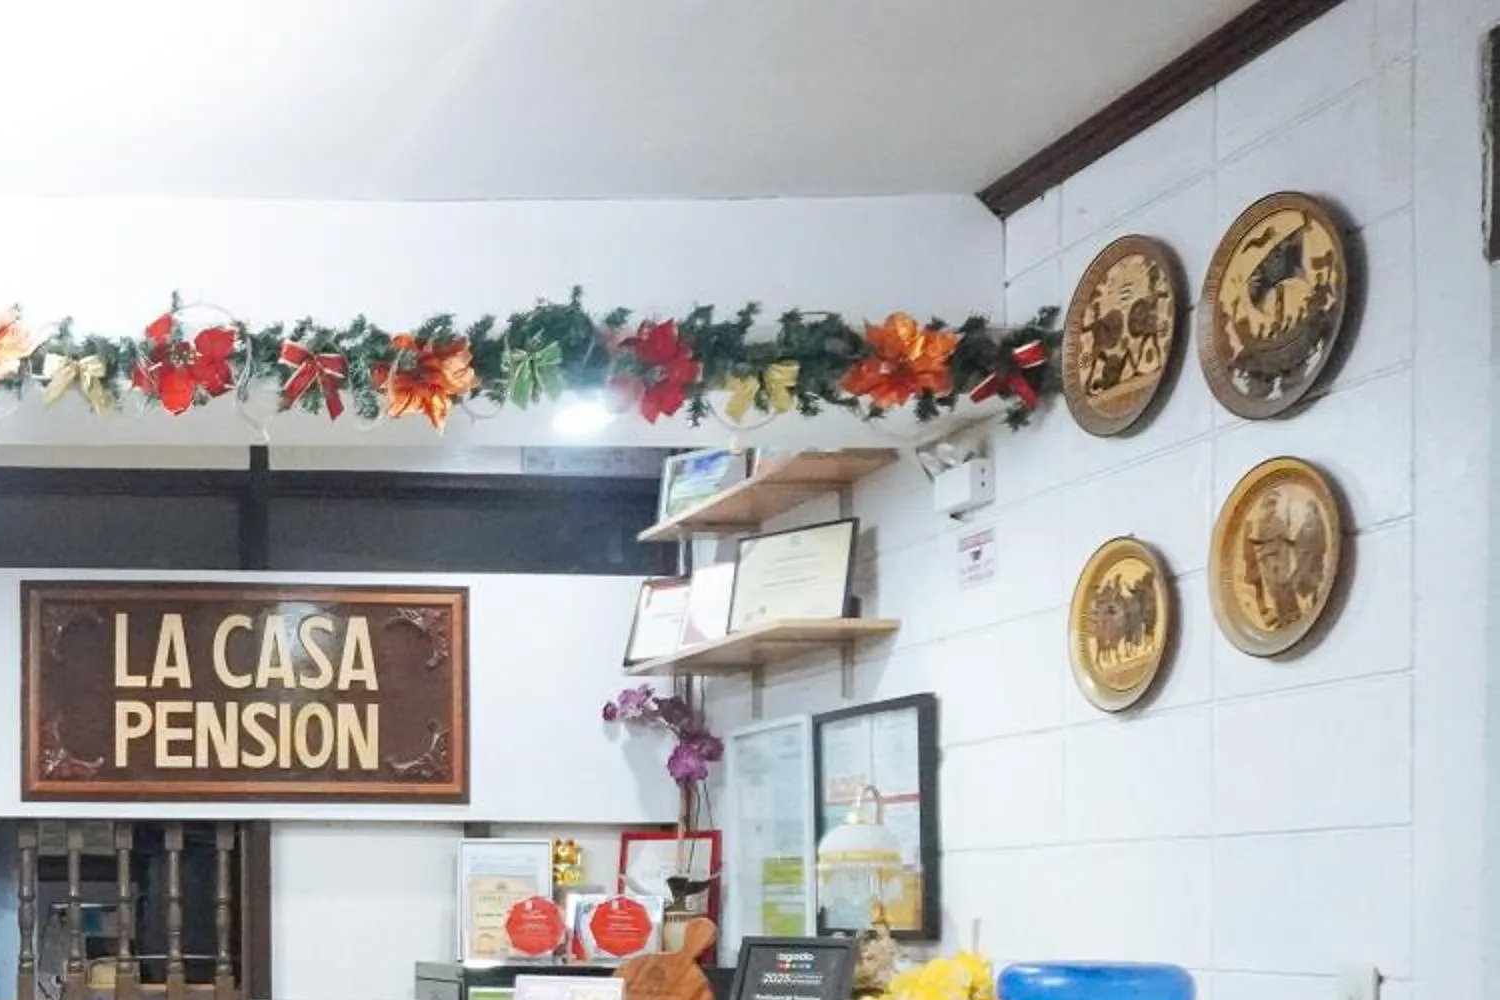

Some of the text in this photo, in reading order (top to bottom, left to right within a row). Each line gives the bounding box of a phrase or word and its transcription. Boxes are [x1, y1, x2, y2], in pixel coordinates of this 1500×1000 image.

[114, 612, 380, 692] LA CASA
[114, 700, 380, 771] PENSION
